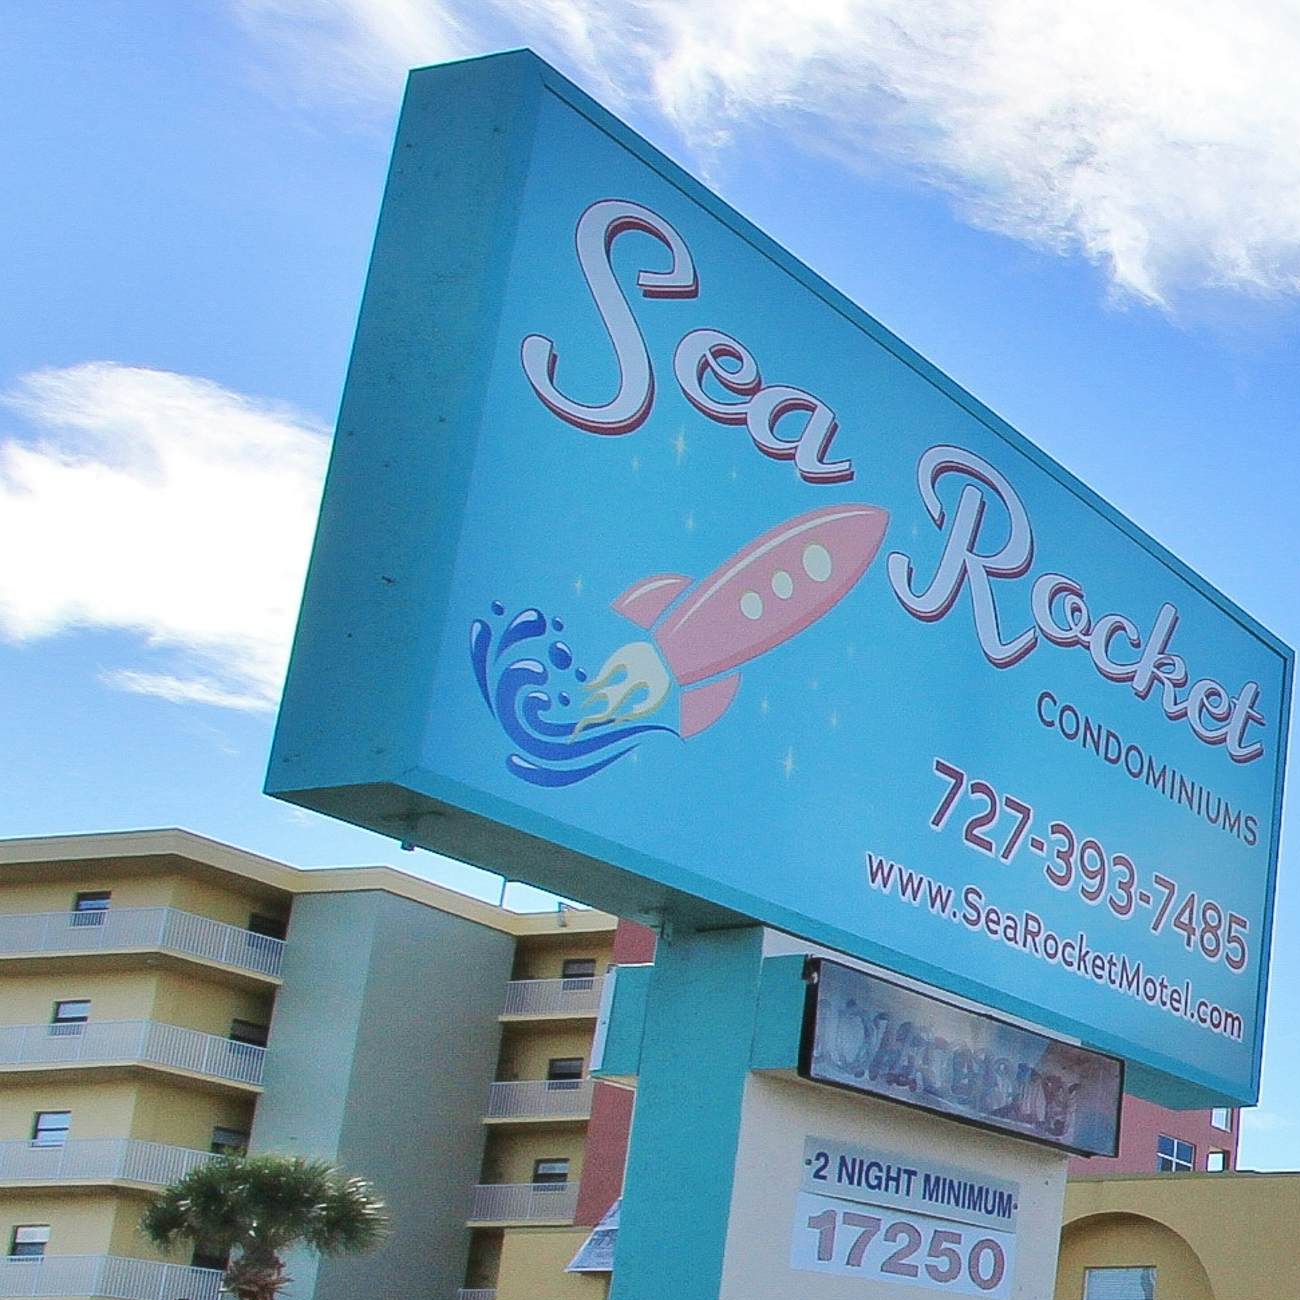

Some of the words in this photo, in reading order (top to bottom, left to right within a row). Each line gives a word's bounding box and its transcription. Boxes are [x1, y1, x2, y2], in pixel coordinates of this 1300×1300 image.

[521, 200, 854, 483] Sea
[886, 444, 1267, 764] Rocket
[1036, 691, 1258, 847] CONDOMINIUMS
[867, 853, 1243, 1041] www.SeaRocketMotel.com
[930, 759, 1249, 972] 727-393-7485
[807, 1209, 1005, 1291] 17250
[812, 1151, 830, 1182] 2
[837, 1156, 917, 1197] NIGHT
[922, 1174, 1014, 1218] MINIMUM
